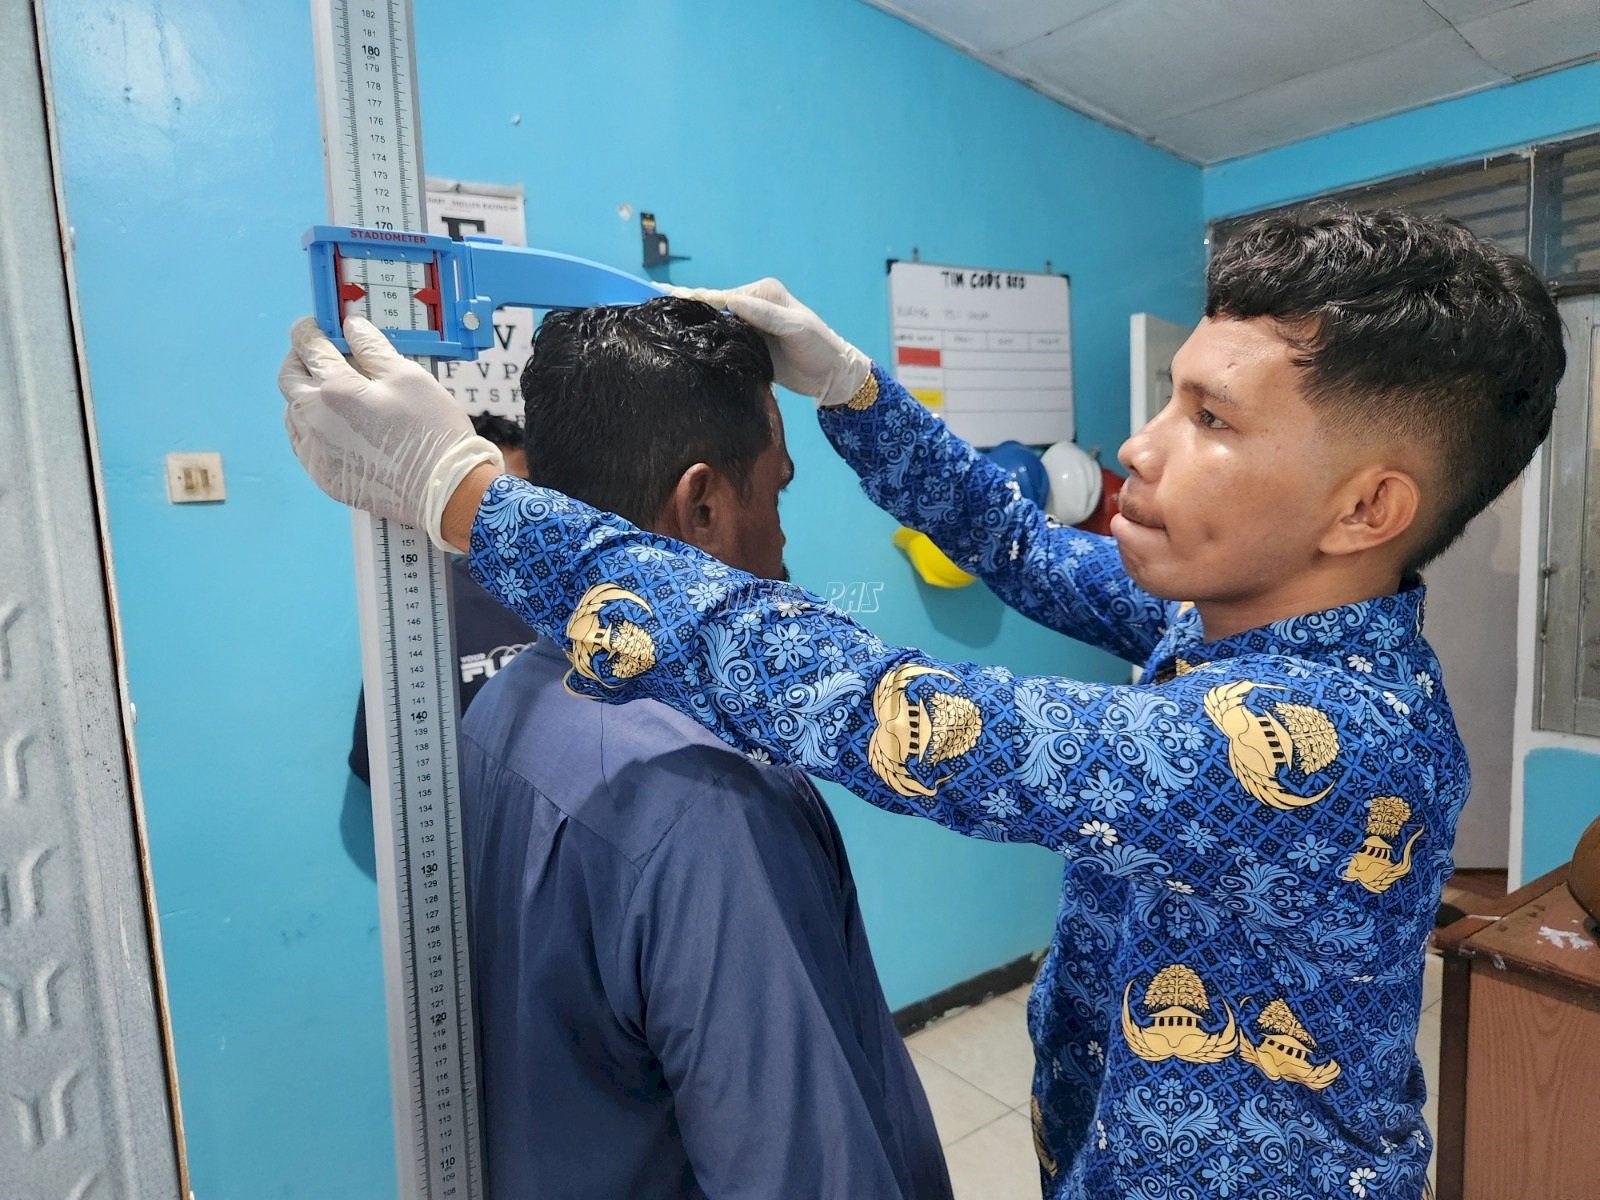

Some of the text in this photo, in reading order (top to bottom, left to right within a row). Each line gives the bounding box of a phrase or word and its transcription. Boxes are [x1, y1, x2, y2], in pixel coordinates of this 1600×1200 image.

[361, 9, 375, 19] 182
[363, 29, 376, 38] 181
[362, 45, 380, 57] 180
[365, 63, 380, 73] 179
[366, 81, 381, 91] 178
[367, 98, 382, 107] 177
[369, 116, 384, 126] 176
[370, 134, 386, 144] 175
[372, 153, 387, 162] 174
[373, 171, 388, 180] 173
[374, 188, 390, 197] 172
[376, 205, 390, 214] 171
[375, 221, 393, 230] 170
[350, 230, 428, 243] STADIOMETER
[380, 274, 395, 282] 167
[382, 291, 398, 300] 166
[383, 309, 399, 317] 165
[445, 362, 518, 379] F V P
[465, 388, 478, 402] T
[489, 388, 500, 402] S
[401, 554, 418, 563] 150
[403, 572, 418, 580] 149
[404, 586, 419, 594] 148
[405, 602, 420, 610] 147
[407, 618, 421, 626] 146
[408, 634, 423, 642] 145
[409, 650, 423, 658] 144
[410, 666, 424, 674] 143
[411, 681, 425, 689] 142
[410, 710, 428, 721] 140
[414, 727, 428, 736] 139
[415, 743, 429, 751] 138
[416, 758, 430, 767] 137
[417, 773, 431, 782] 136
[418, 789, 432, 798] 135
[418, 804, 433, 813] 134
[419, 819, 434, 828] 133
[421, 834, 435, 844] 132
[422, 850, 435, 859] 131
[421, 863, 438, 874] 130
[423, 880, 438, 889] 129
[424, 894, 439, 904] 128
[425, 909, 439, 919] 127
[426, 924, 440, 934] 126
[427, 939, 441, 949] 125
[428, 955, 442, 964] 124
[429, 969, 443, 979] 123
[430, 984, 444, 994] 122
[431, 999, 444, 1008] 121
[430, 1012, 447, 1024] 120
[433, 1028, 446, 1038] 119
[433, 1043, 447, 1052] 118
[435, 1057, 448, 1067] 117
[436, 1073, 449, 1082] 116
[437, 1087, 450, 1096] 115
[438, 1101, 451, 1110] 114
[438, 1115, 452, 1125] 113
[439, 1129, 452, 1139] 112
[441, 1145, 452, 1154] 111
[440, 1156, 456, 1169] 110
[442, 1172, 456, 1183] 109
[443, 1187, 456, 1197] 108
